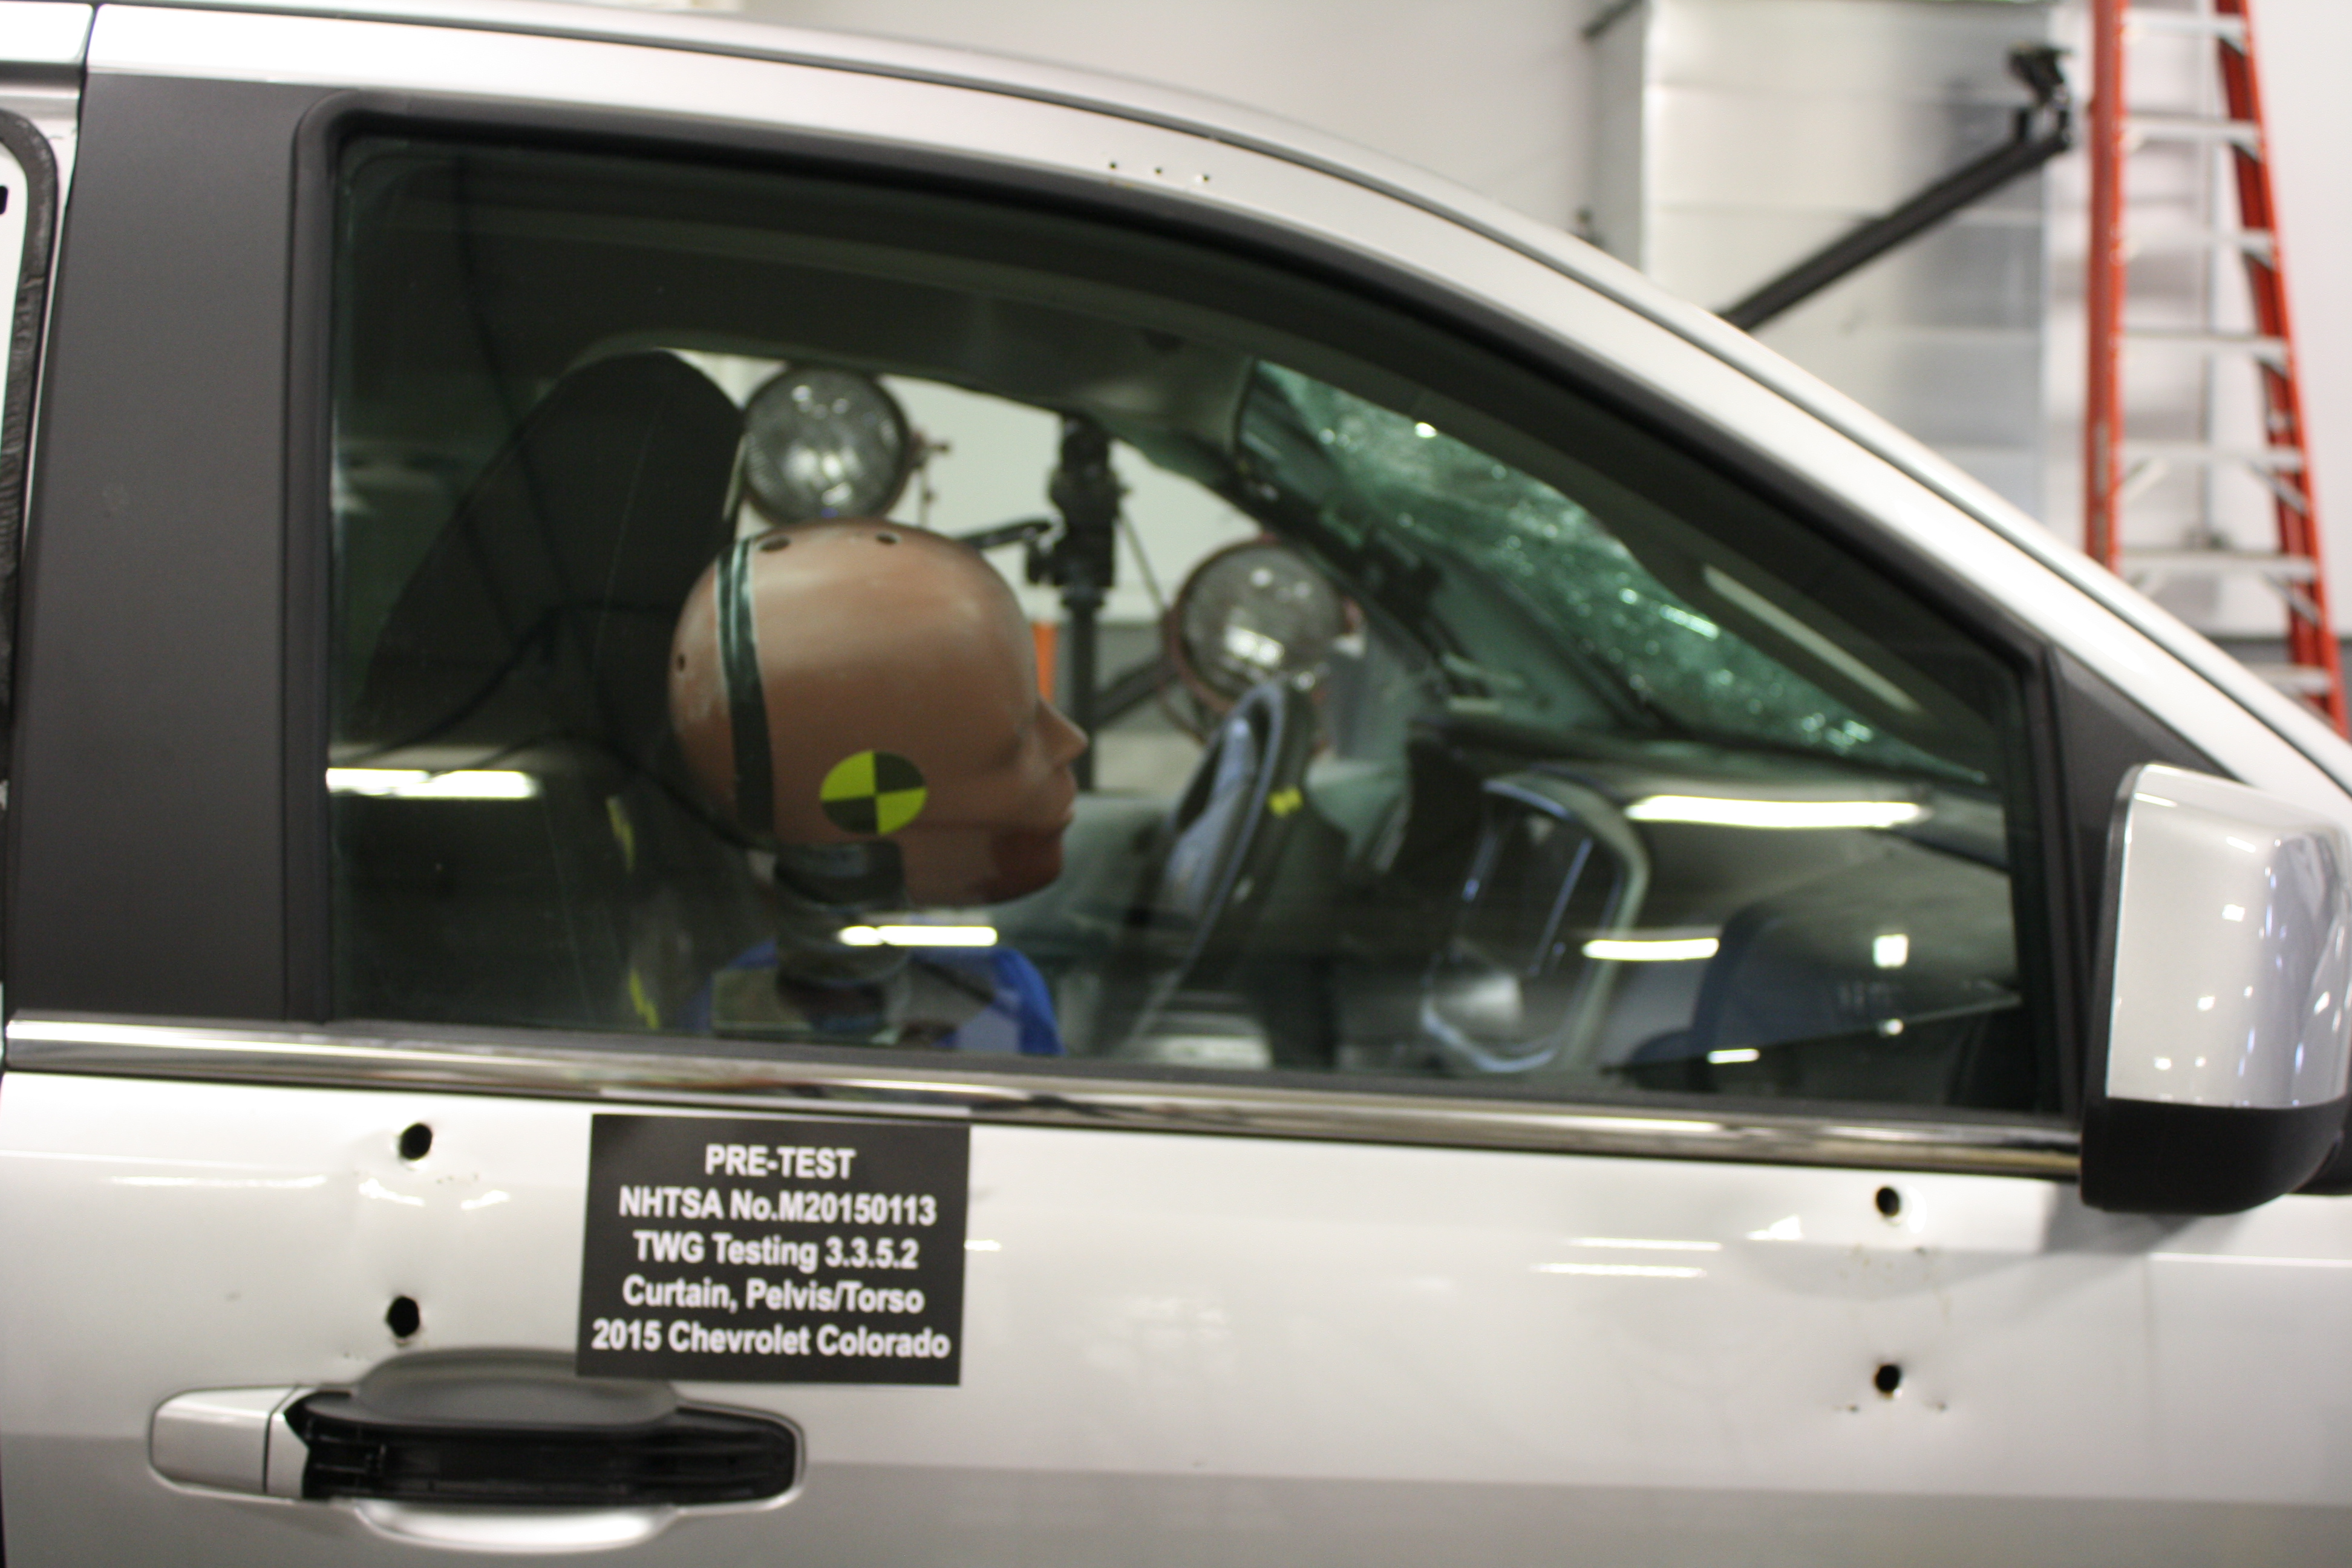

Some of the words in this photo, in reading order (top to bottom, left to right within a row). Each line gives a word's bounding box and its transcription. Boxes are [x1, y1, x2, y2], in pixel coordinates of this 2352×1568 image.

[704, 1143, 857, 1180] PRE-TEST
[618, 1184, 725, 1220] NHTSA
[730, 1188, 937, 1226] No.M20150113
[632, 1229, 705, 1264] TWG
[711, 1232, 818, 1274] Testing
[825, 1235, 920, 1270] 3.3.5.2
[622, 1273, 738, 1313] Curtain,
[746, 1278, 925, 1314] Pelvis/Torso
[591, 1318, 662, 1351] 2015
[668, 1319, 811, 1355] Chevrolet
[816, 1324, 951, 1358] Colorado
